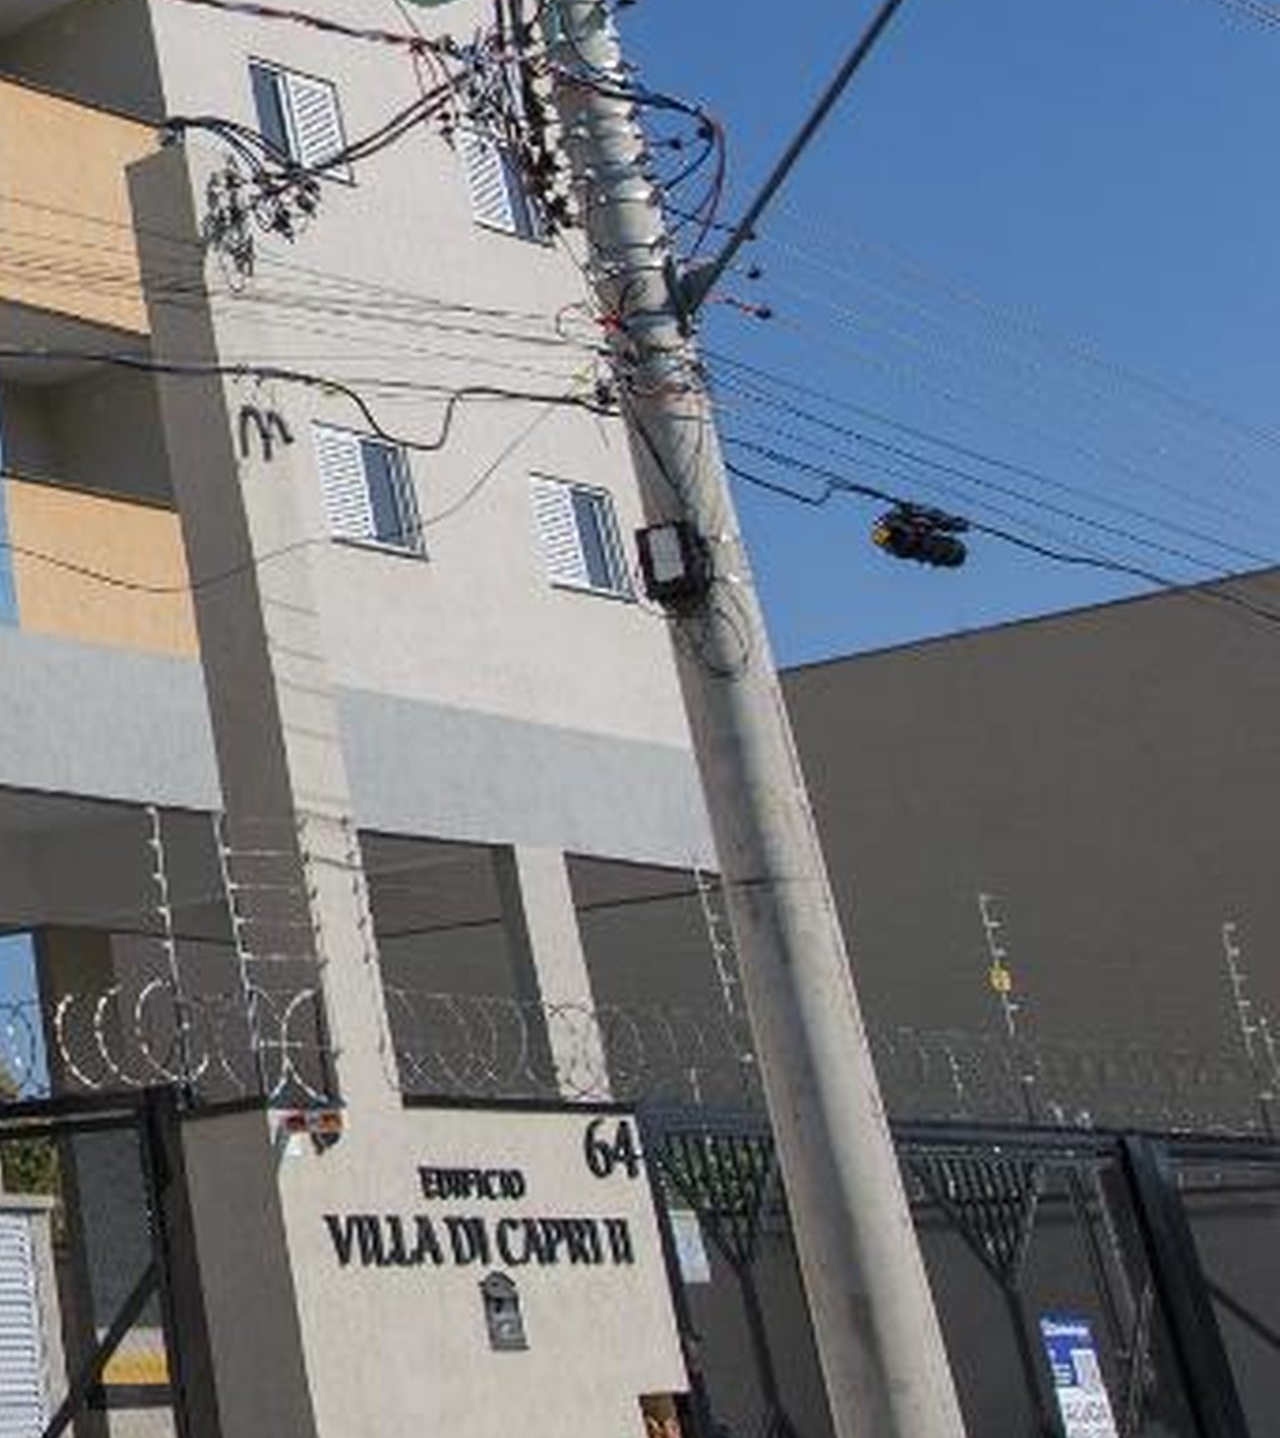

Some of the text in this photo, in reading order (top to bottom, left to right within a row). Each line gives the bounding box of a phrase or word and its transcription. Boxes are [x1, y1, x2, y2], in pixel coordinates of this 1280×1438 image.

[584, 1118, 641, 1179] 64
[324, 1214, 443, 1269] VILLA
[444, 1217, 489, 1267] DI
[496, 1218, 608, 1267] CAPRI
